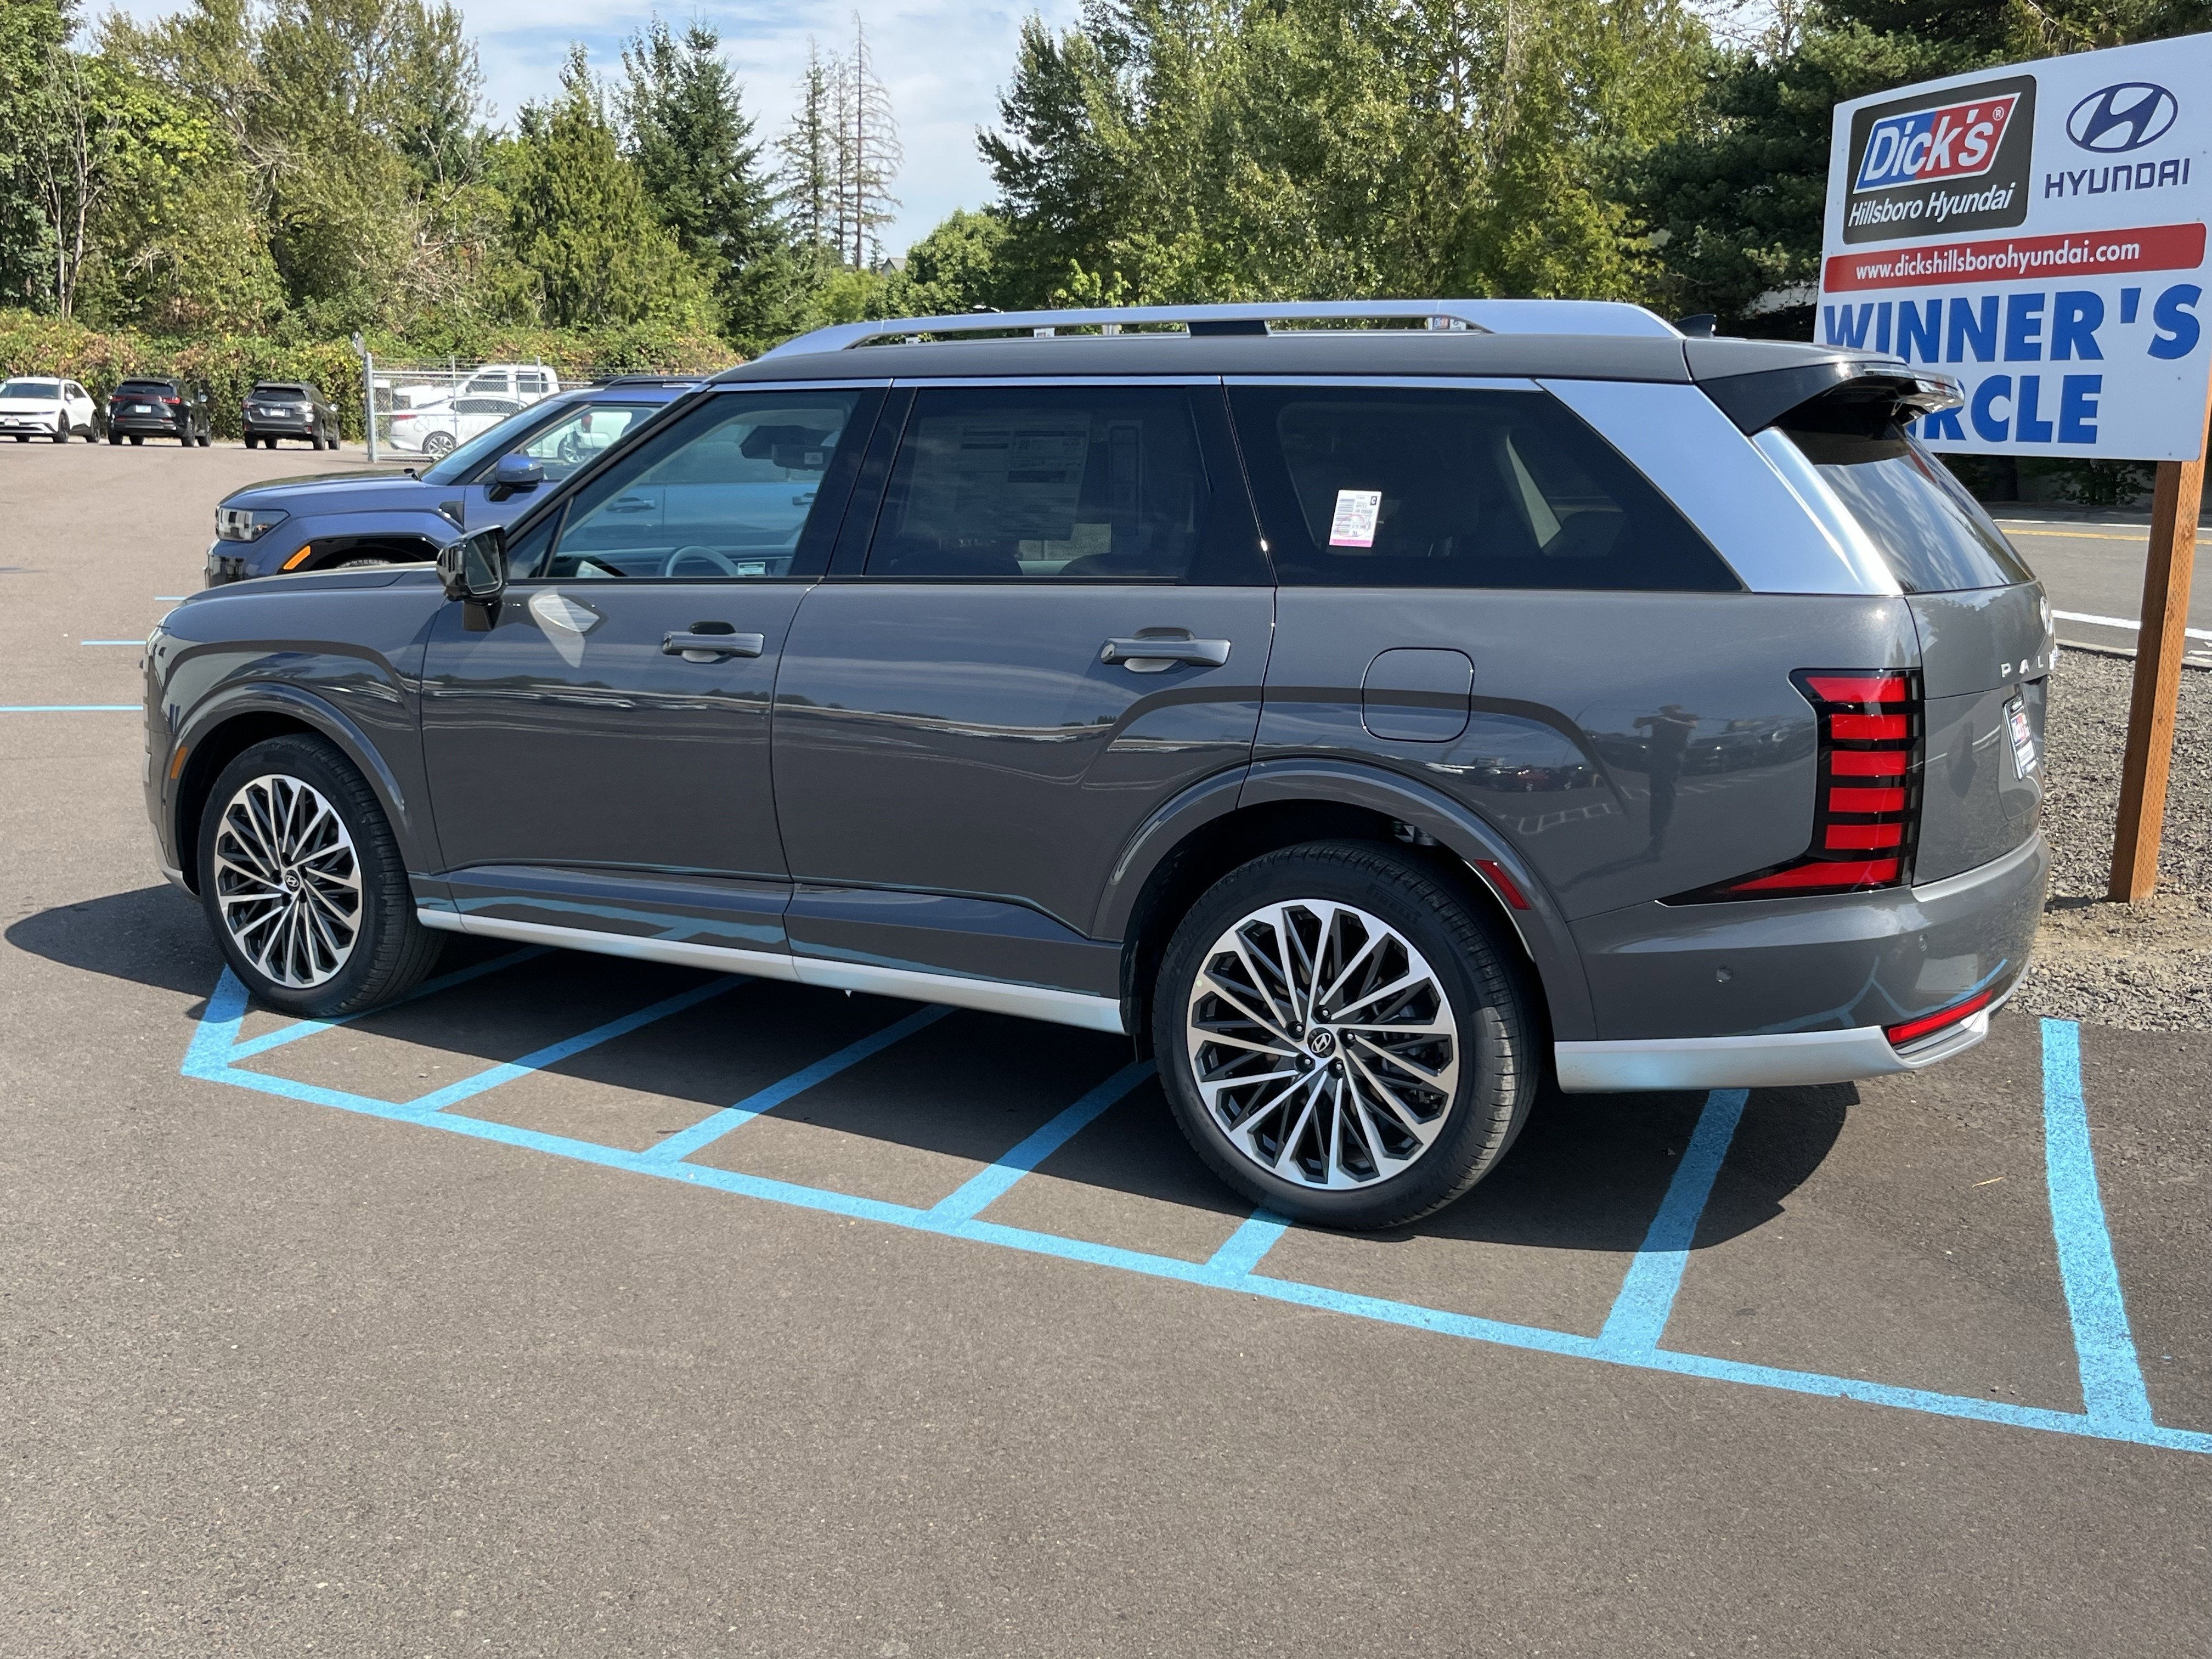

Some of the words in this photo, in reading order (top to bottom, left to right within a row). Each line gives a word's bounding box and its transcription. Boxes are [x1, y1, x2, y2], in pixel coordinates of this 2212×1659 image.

[1864, 109, 1994, 182] Dick's
[2044, 158, 2190, 199] HYUNDAI
[1848, 198, 1922, 227] Hillsboro
[1925, 182, 2016, 223] Hyundai
[1856, 240, 2140, 280] www.dickshillsborohyundai.com
[1824, 284, 2202, 363] WINNER'S
